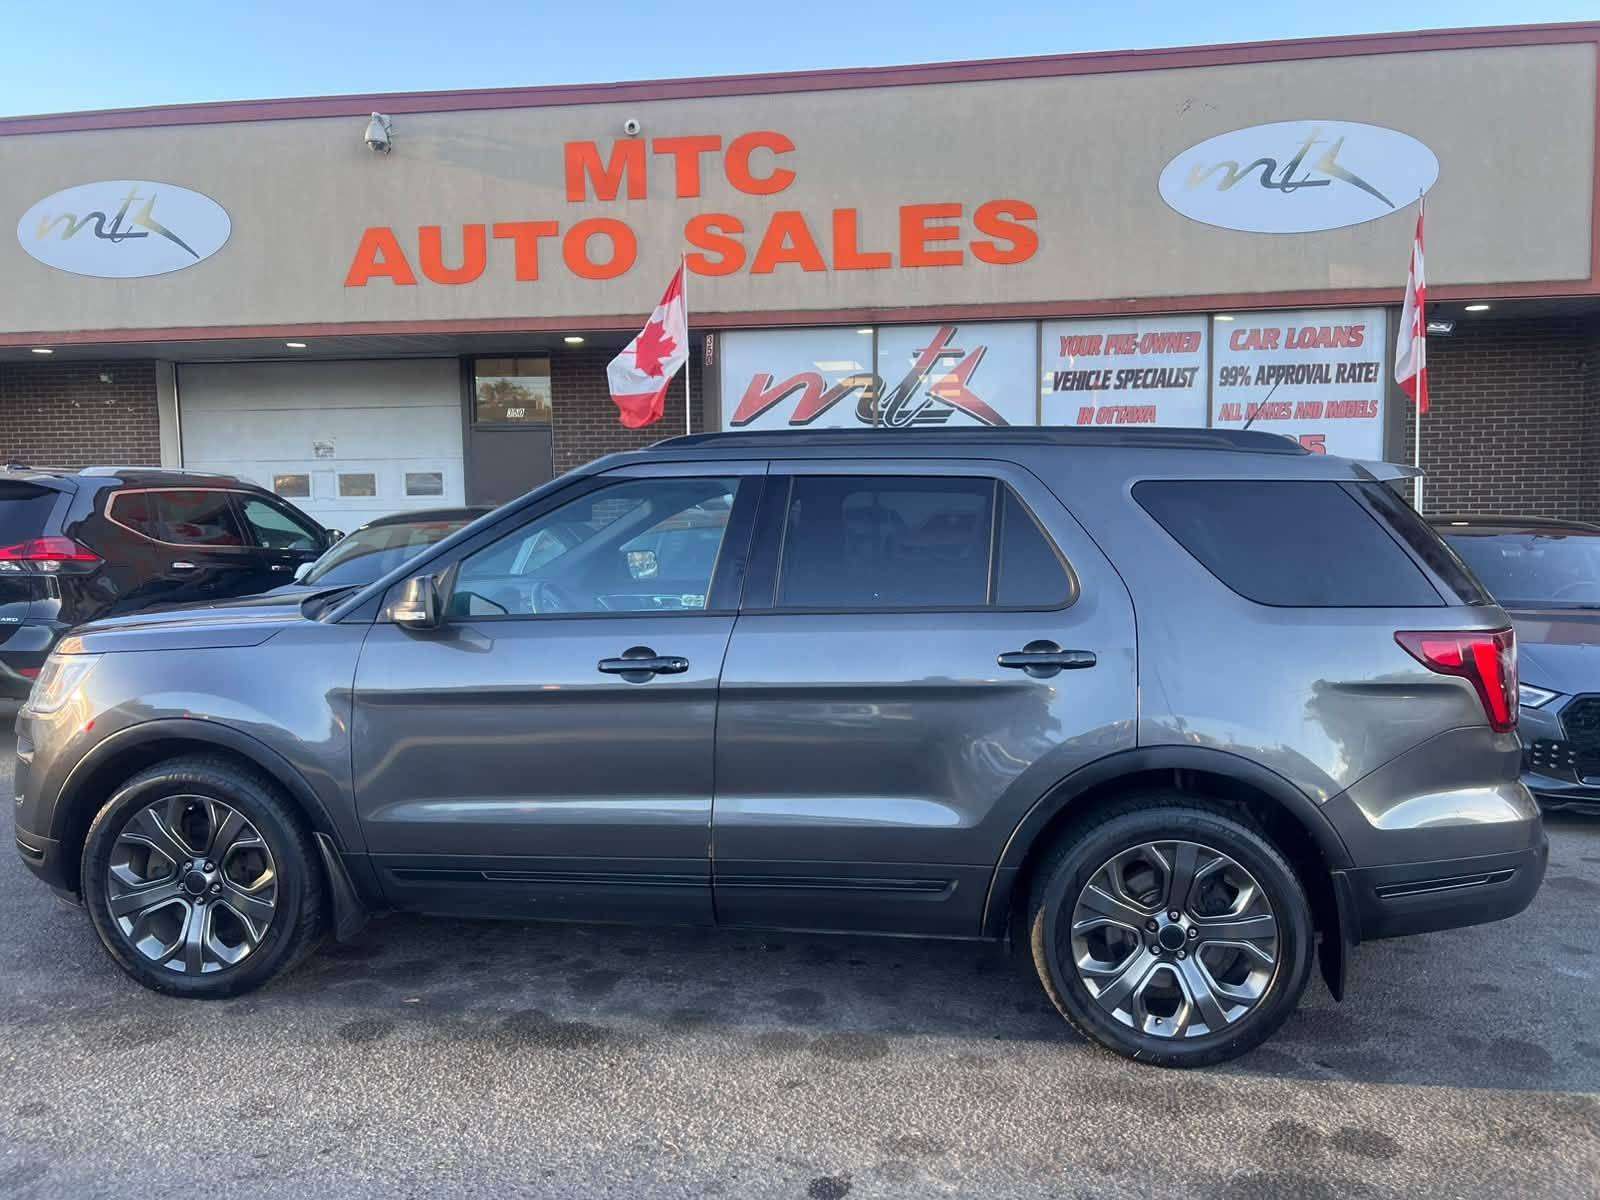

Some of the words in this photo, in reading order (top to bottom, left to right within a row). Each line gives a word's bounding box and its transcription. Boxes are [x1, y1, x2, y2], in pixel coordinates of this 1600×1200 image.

[564, 131, 795, 202] MTC
[345, 218, 637, 287] AUTO
[684, 200, 1039, 276] SALES
[1059, 335, 1103, 357] YOUR
[1229, 327, 1281, 351] CAR
[1284, 325, 1366, 349] LOANS
[1053, 369, 1113, 391] VEHICLE
[1113, 366, 1200, 390] SPECIALIST
[1219, 366, 1251, 386] 99%
[1254, 362, 1332, 386] APPROVAL
[1334, 362, 1380, 384] RATE!
[1076, 406, 1096, 425] IN
[1095, 405, 1157, 424] OTTAWA
[1244, 401, 1292, 421] MAKES
[1293, 401, 1323, 420] AND
[1324, 400, 1379, 419] MODELS
